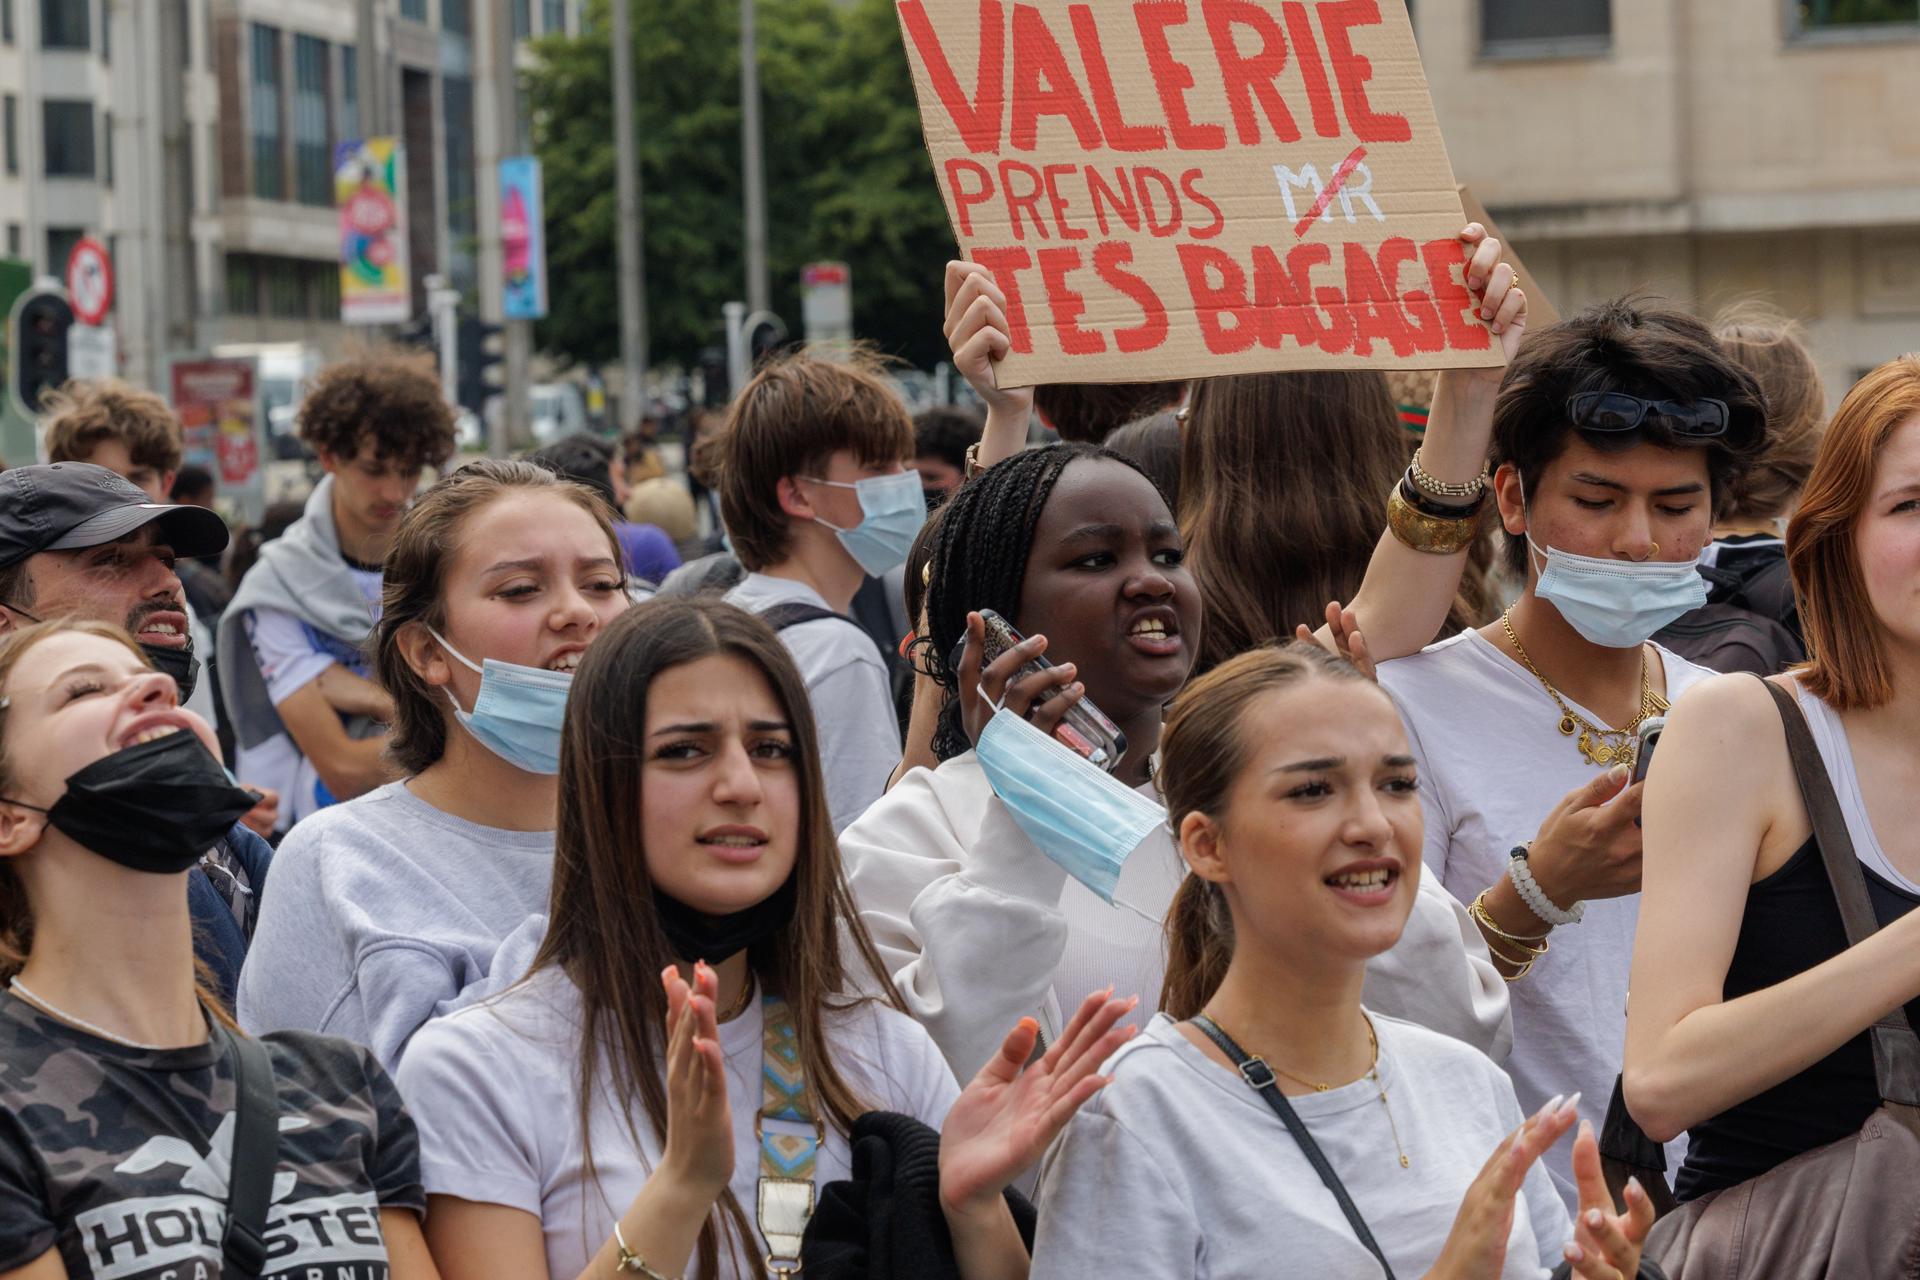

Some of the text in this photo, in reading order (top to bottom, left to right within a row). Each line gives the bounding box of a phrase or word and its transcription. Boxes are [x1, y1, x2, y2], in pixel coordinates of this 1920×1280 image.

[899, 0, 1412, 155] VALERIE
[944, 157, 1386, 240] PRENDS MR
[970, 236, 1492, 358] TES BAGAGE
